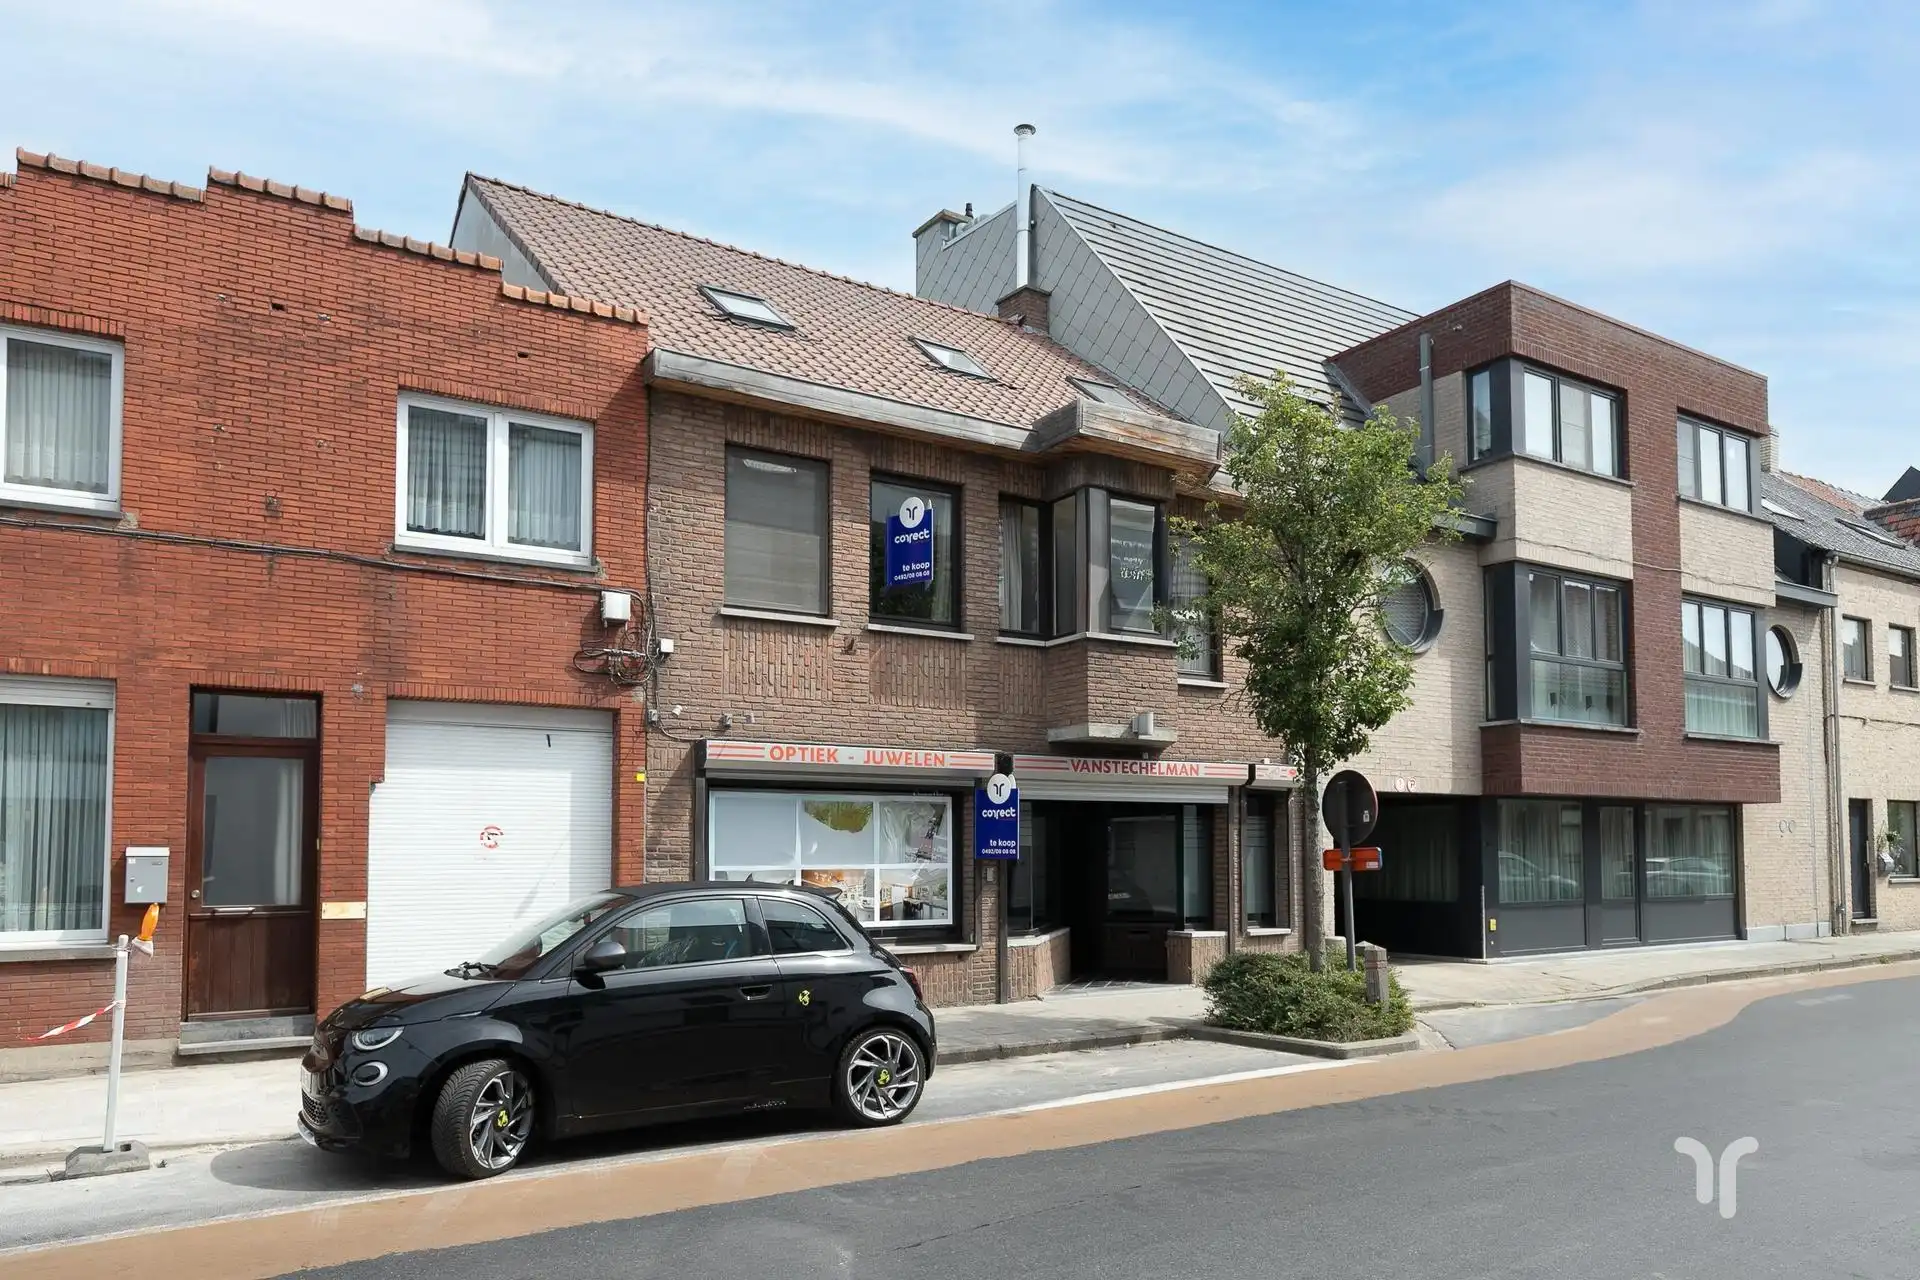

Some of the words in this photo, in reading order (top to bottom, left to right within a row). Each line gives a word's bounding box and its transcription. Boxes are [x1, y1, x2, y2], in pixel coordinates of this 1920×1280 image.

[902, 564, 911, 572] te
[911, 562, 930, 571] koop
[769, 745, 839, 763] OPTIEK
[863, 750, 946, 767] JUWELEN
[1071, 759, 1200, 776] VANSTECHELMAN
[990, 839, 997, 847] te
[998, 838, 1016, 848] koop
